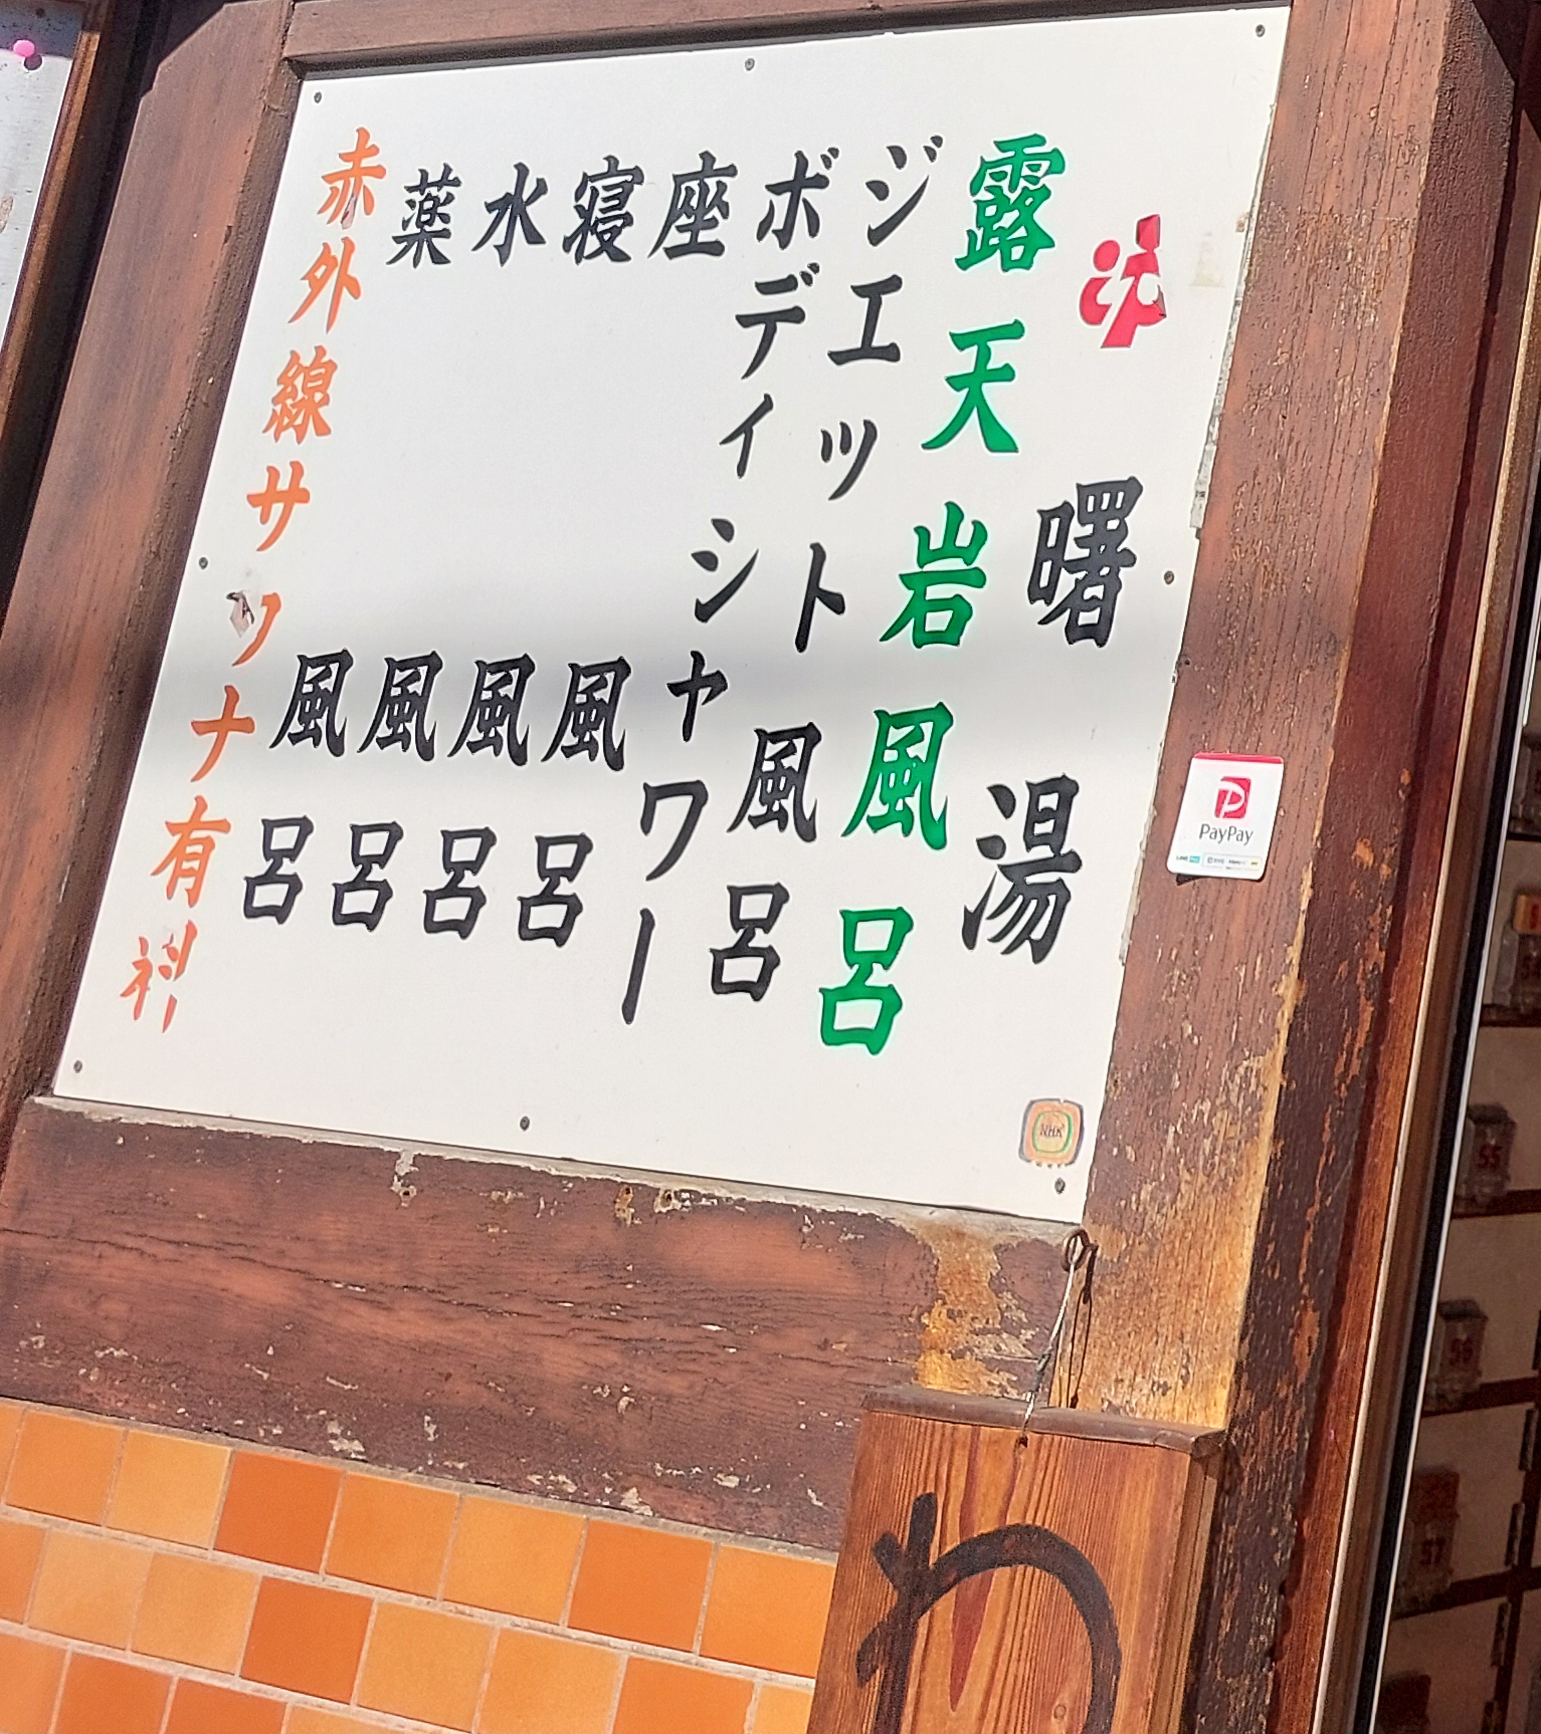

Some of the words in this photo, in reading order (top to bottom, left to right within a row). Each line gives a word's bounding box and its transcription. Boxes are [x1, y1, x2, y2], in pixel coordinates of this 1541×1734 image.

[819, 132, 1067, 1056] 露天岩風呂
[961, 476, 1143, 965] 曙湯
[1199, 823, 1254, 846] PayPay
[1039, 1123, 1065, 1138] NHK
